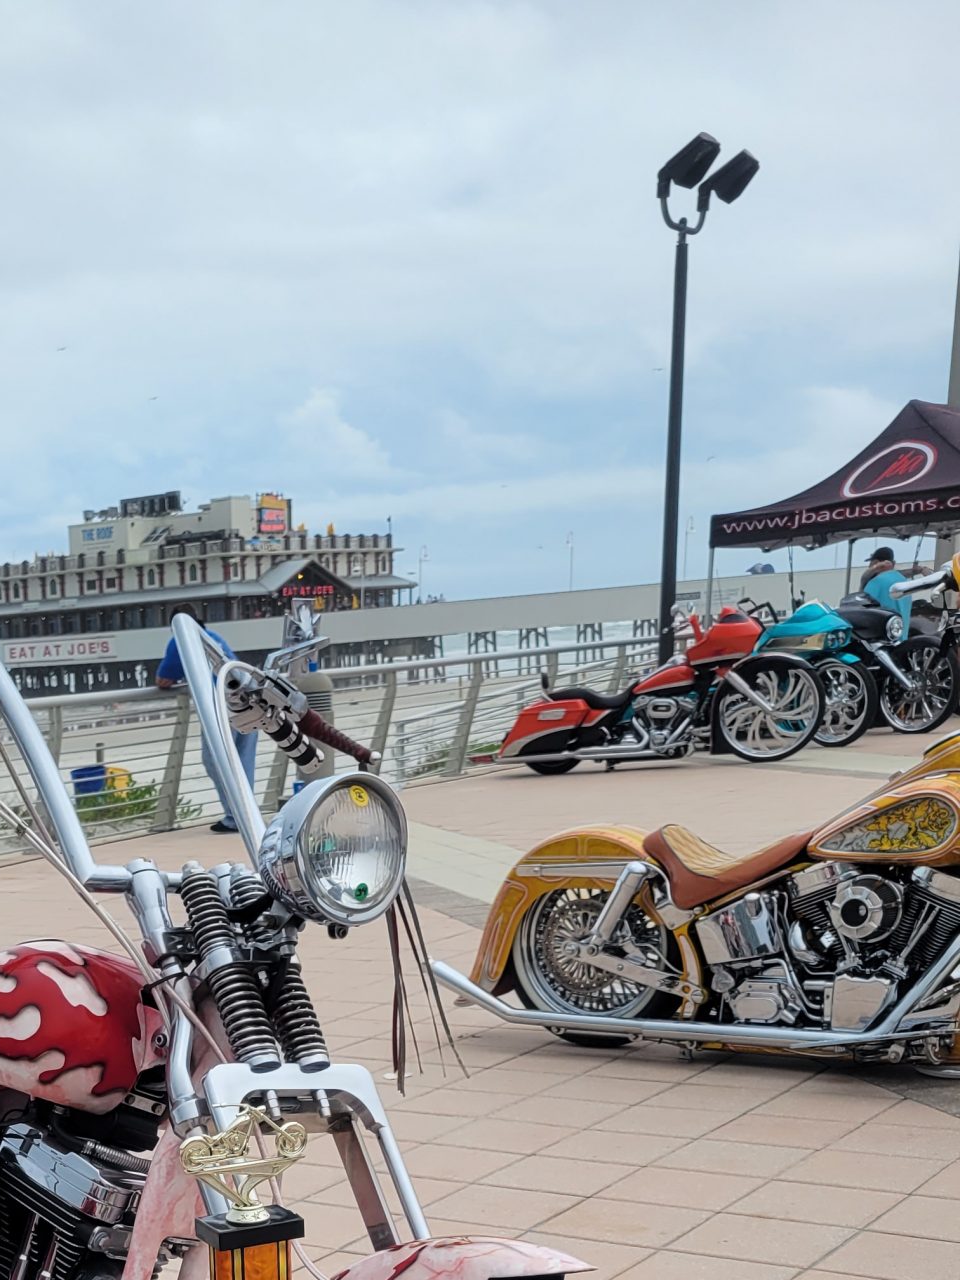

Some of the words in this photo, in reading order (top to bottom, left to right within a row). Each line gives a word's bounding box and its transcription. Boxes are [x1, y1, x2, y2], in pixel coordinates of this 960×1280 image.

[282, 586, 298, 597] EAT
[299, 585, 311, 596] AT
[311, 584, 334, 596] JOE'S
[9, 646, 37, 660] EAT
[42, 644, 62, 658] AT
[67, 641, 111, 656] JOE'S
